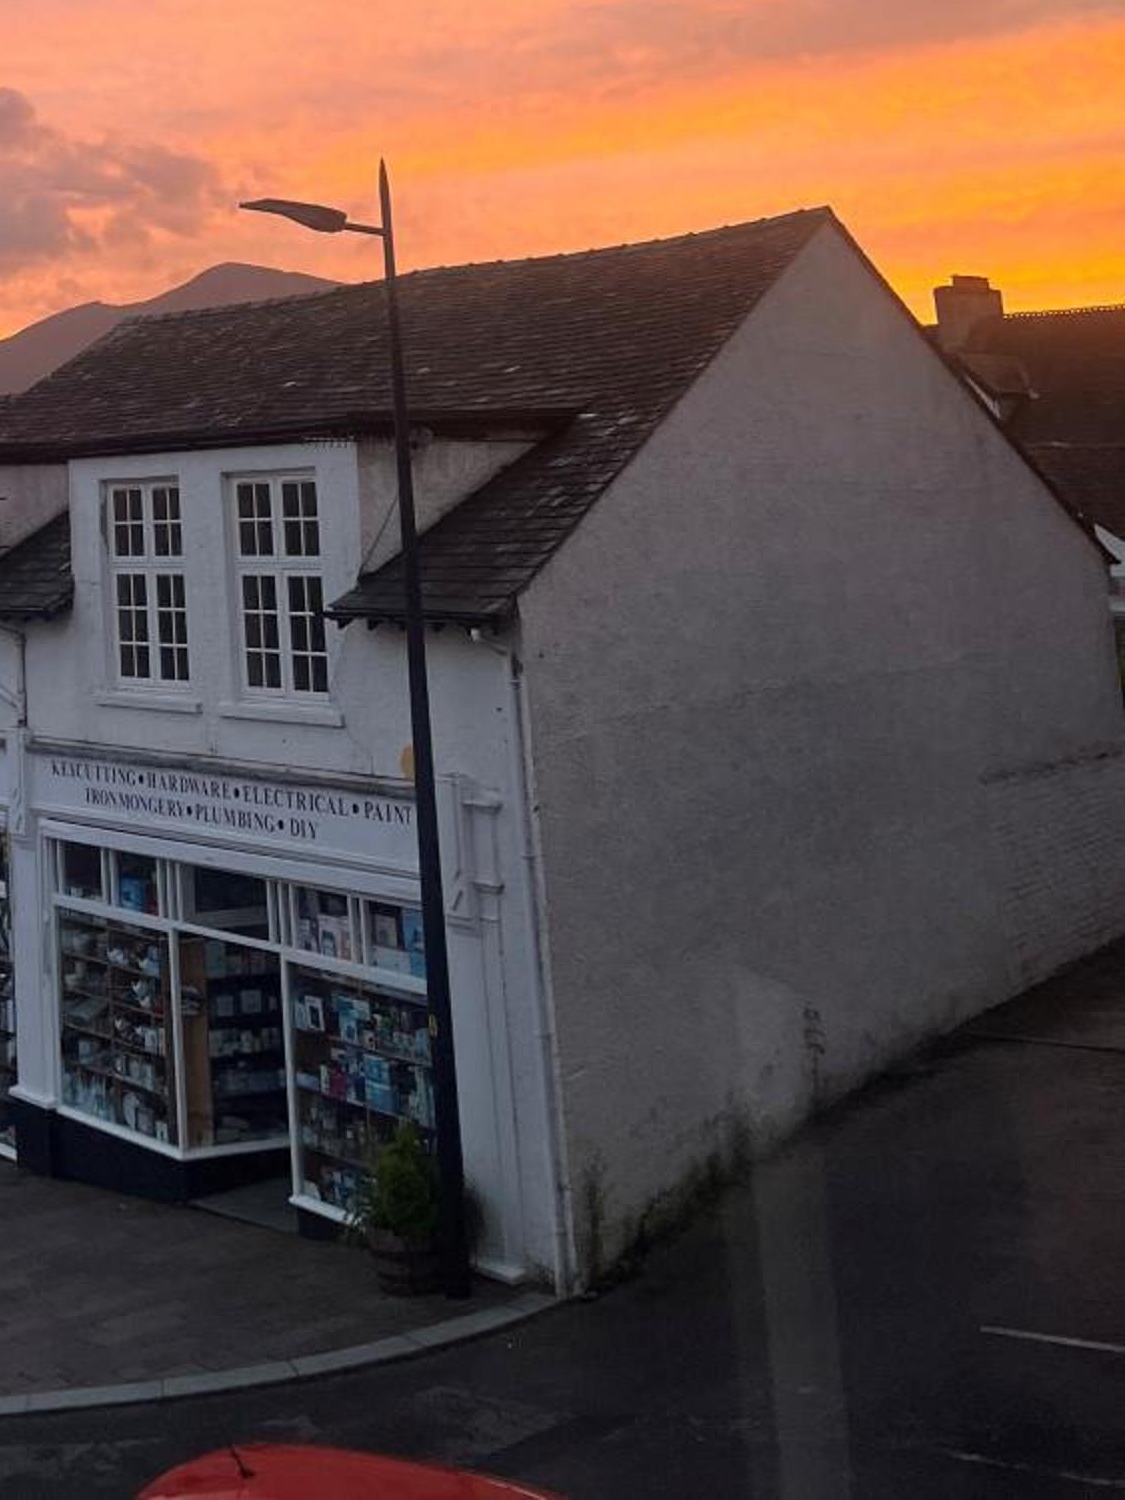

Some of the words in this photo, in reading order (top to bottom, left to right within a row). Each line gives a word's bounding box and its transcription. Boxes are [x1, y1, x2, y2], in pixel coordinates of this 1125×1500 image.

[51, 760, 136, 786] KEYCUTTING
[147, 772, 232, 800] HARDWARE
[242, 785, 349, 817] ELECTRICAL
[85, 788, 184, 817] IRONMONGERY
[196, 806, 275, 833] PLUMBING
[291, 819, 316, 840] DIY
